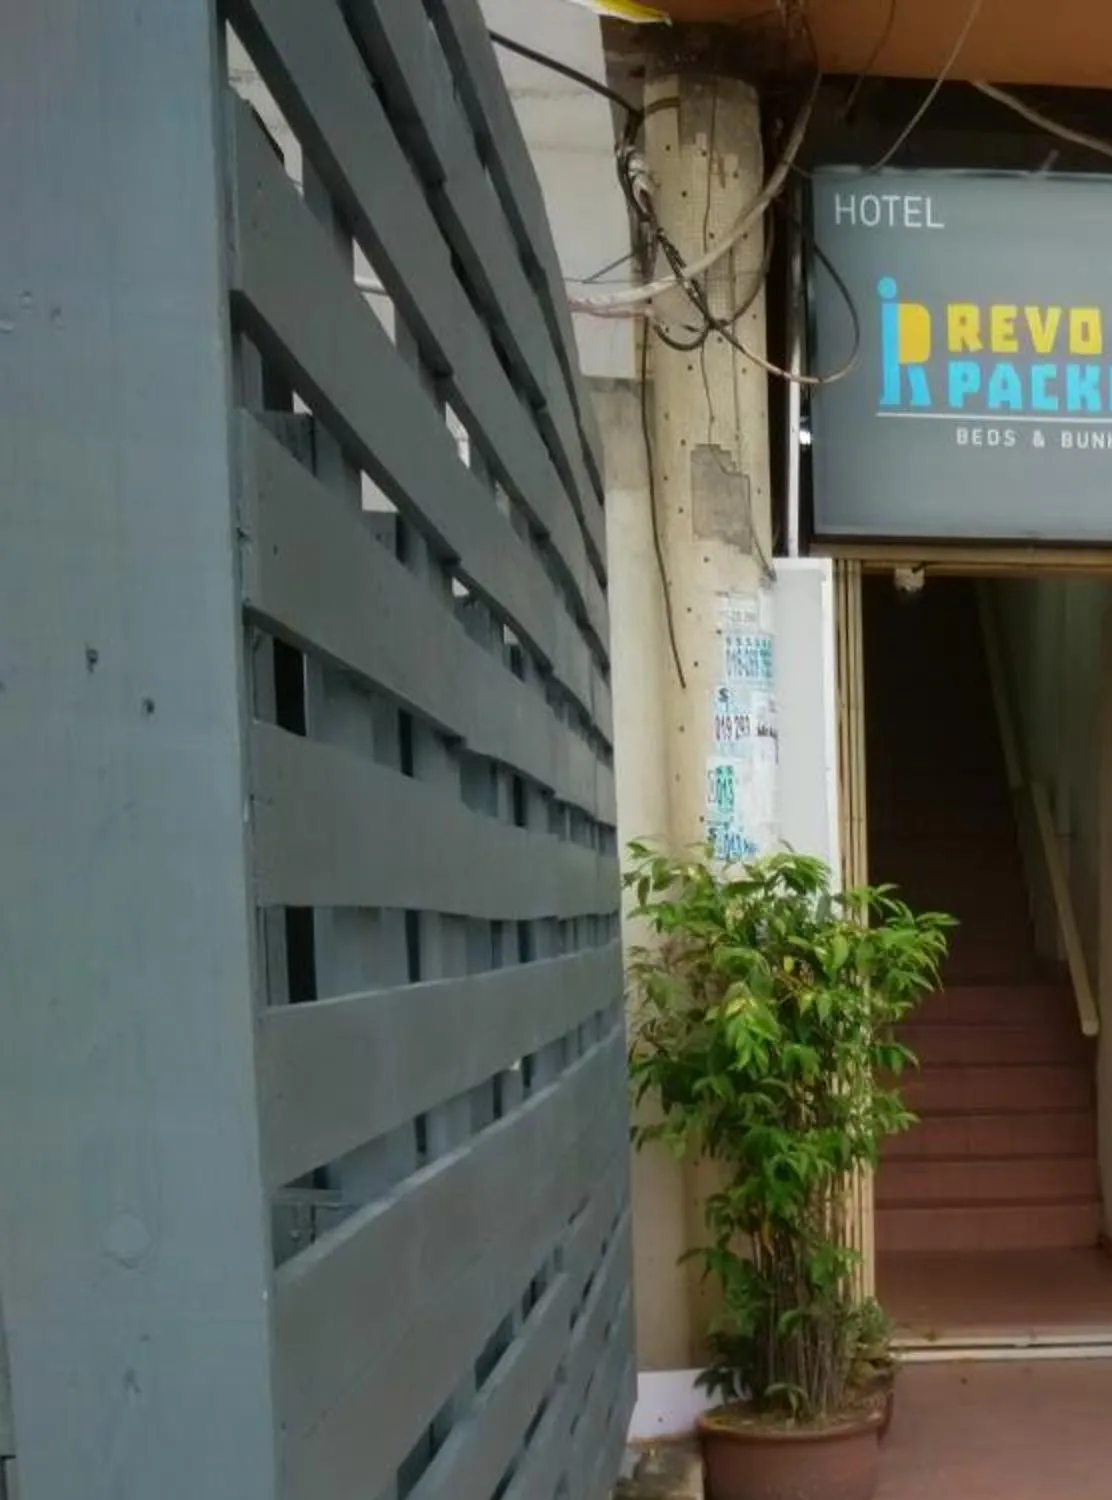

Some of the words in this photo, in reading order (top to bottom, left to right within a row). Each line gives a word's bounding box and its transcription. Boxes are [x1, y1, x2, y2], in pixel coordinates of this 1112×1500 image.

[834, 193, 945, 229] HOTEL
[947, 302, 1103, 354] REVO
[956, 428, 1017, 447] BEDS
[1032, 431, 1046, 448] &
